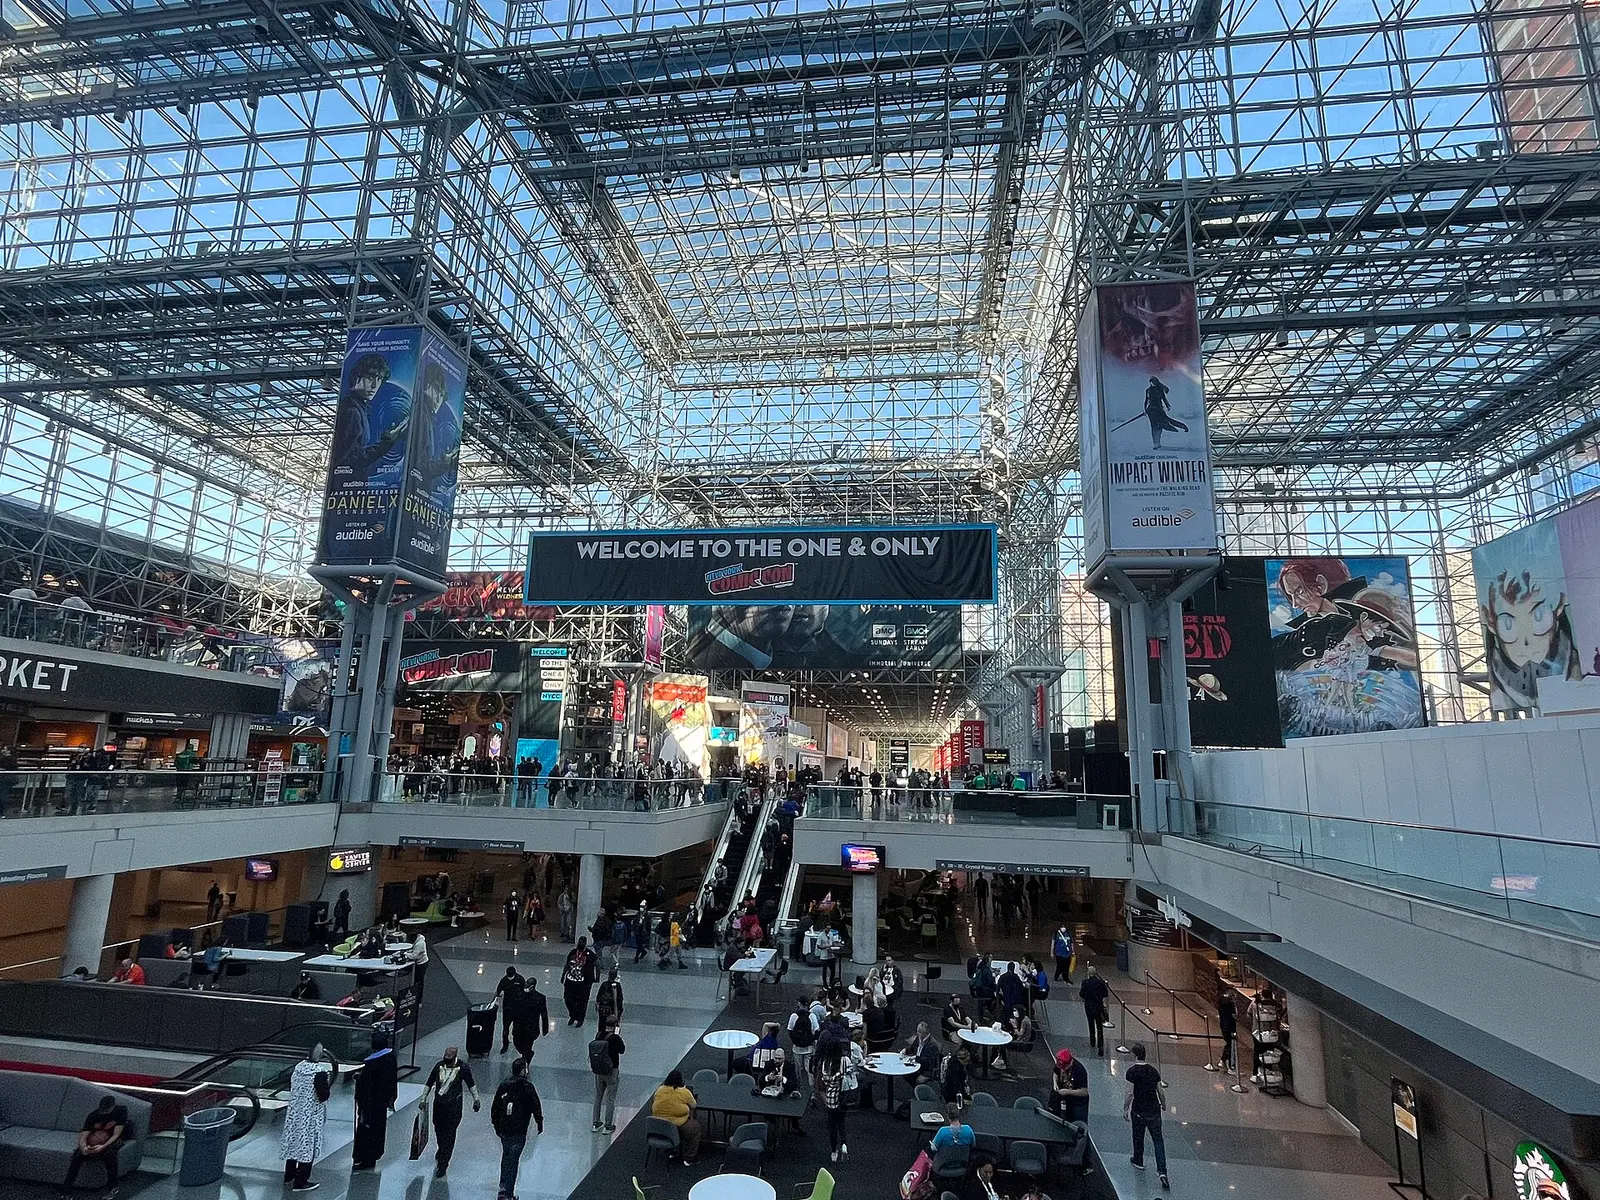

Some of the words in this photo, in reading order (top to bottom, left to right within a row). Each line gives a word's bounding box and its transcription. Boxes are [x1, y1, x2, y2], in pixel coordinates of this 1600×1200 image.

[1110, 462, 1154, 484] IMPACT
[1158, 460, 1206, 484] WINTER
[327, 496, 385, 510] DANIEL
[389, 495, 397, 508] X
[405, 498, 441, 528] DANIEL
[443, 519, 450, 531] X
[1132, 515, 1181, 527] audible
[336, 530, 373, 540] audible
[411, 537, 435, 555] audible
[577, 540, 694, 559] WELCOME
[699, 539, 732, 558] TO
[735, 538, 782, 557] THE
[788, 537, 841, 557] ONE
[848, 537, 866, 556] &
[870, 537, 940, 556] ONLY
[706, 570, 722, 582] NEW
[722, 565, 742, 578] YORK
[711, 571, 760, 593] COMIC
[761, 564, 792, 584] CON
[401, 658, 418, 668] NEW
[418, 650, 438, 663] YORK
[459, 652, 492, 672] CON
